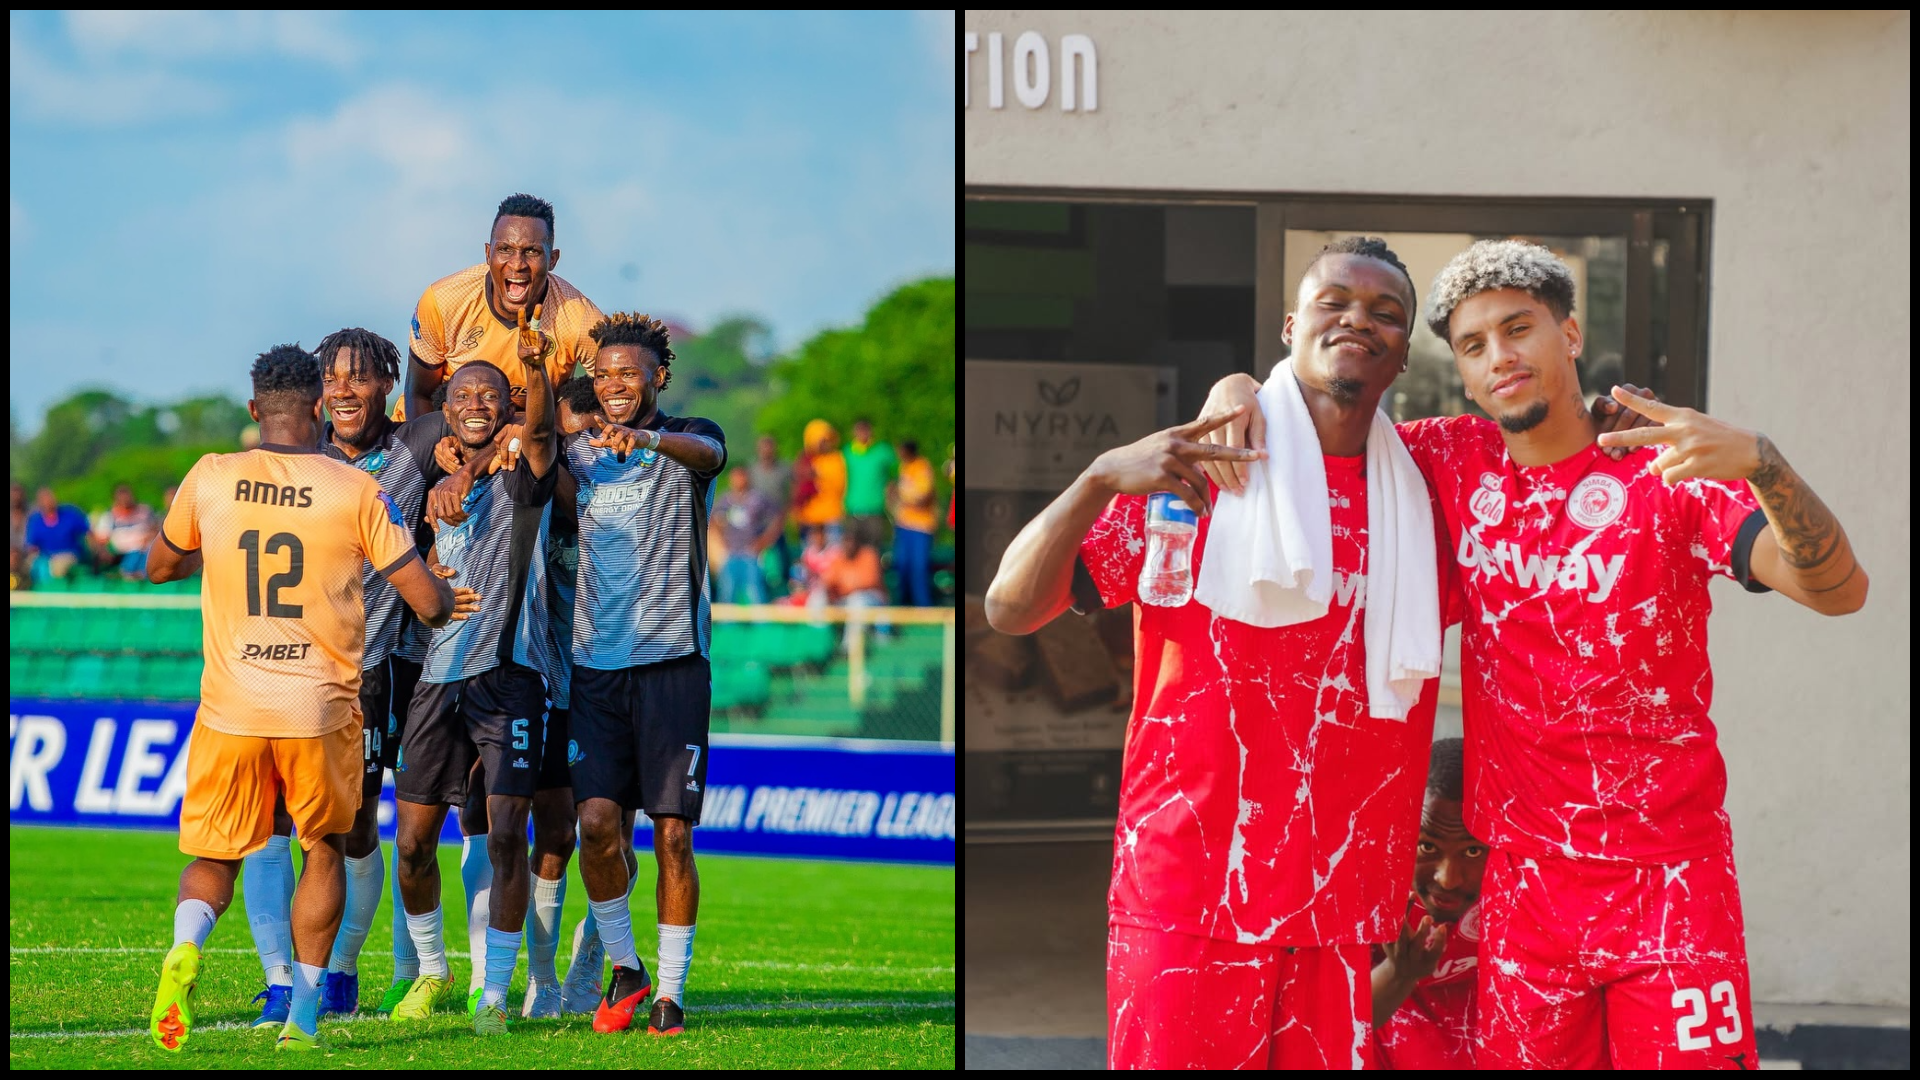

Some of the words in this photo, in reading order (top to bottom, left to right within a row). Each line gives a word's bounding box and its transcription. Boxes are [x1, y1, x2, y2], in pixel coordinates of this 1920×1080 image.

[994, 411, 1120, 436] NYRYA
[234, 479, 313, 508] AMAS
[595, 483, 652, 503] BOOST
[1582, 479, 1612, 489] SIMBA
[590, 506, 619, 514] ENERGY
[1473, 490, 1502, 522] Cola
[238, 529, 304, 619] 12
[363, 727, 381, 760] 14
[512, 718, 529, 750] 5
[686, 743, 701, 776] 7
[746, 786, 881, 836] PREMIER
[1671, 980, 1743, 1051] 23
